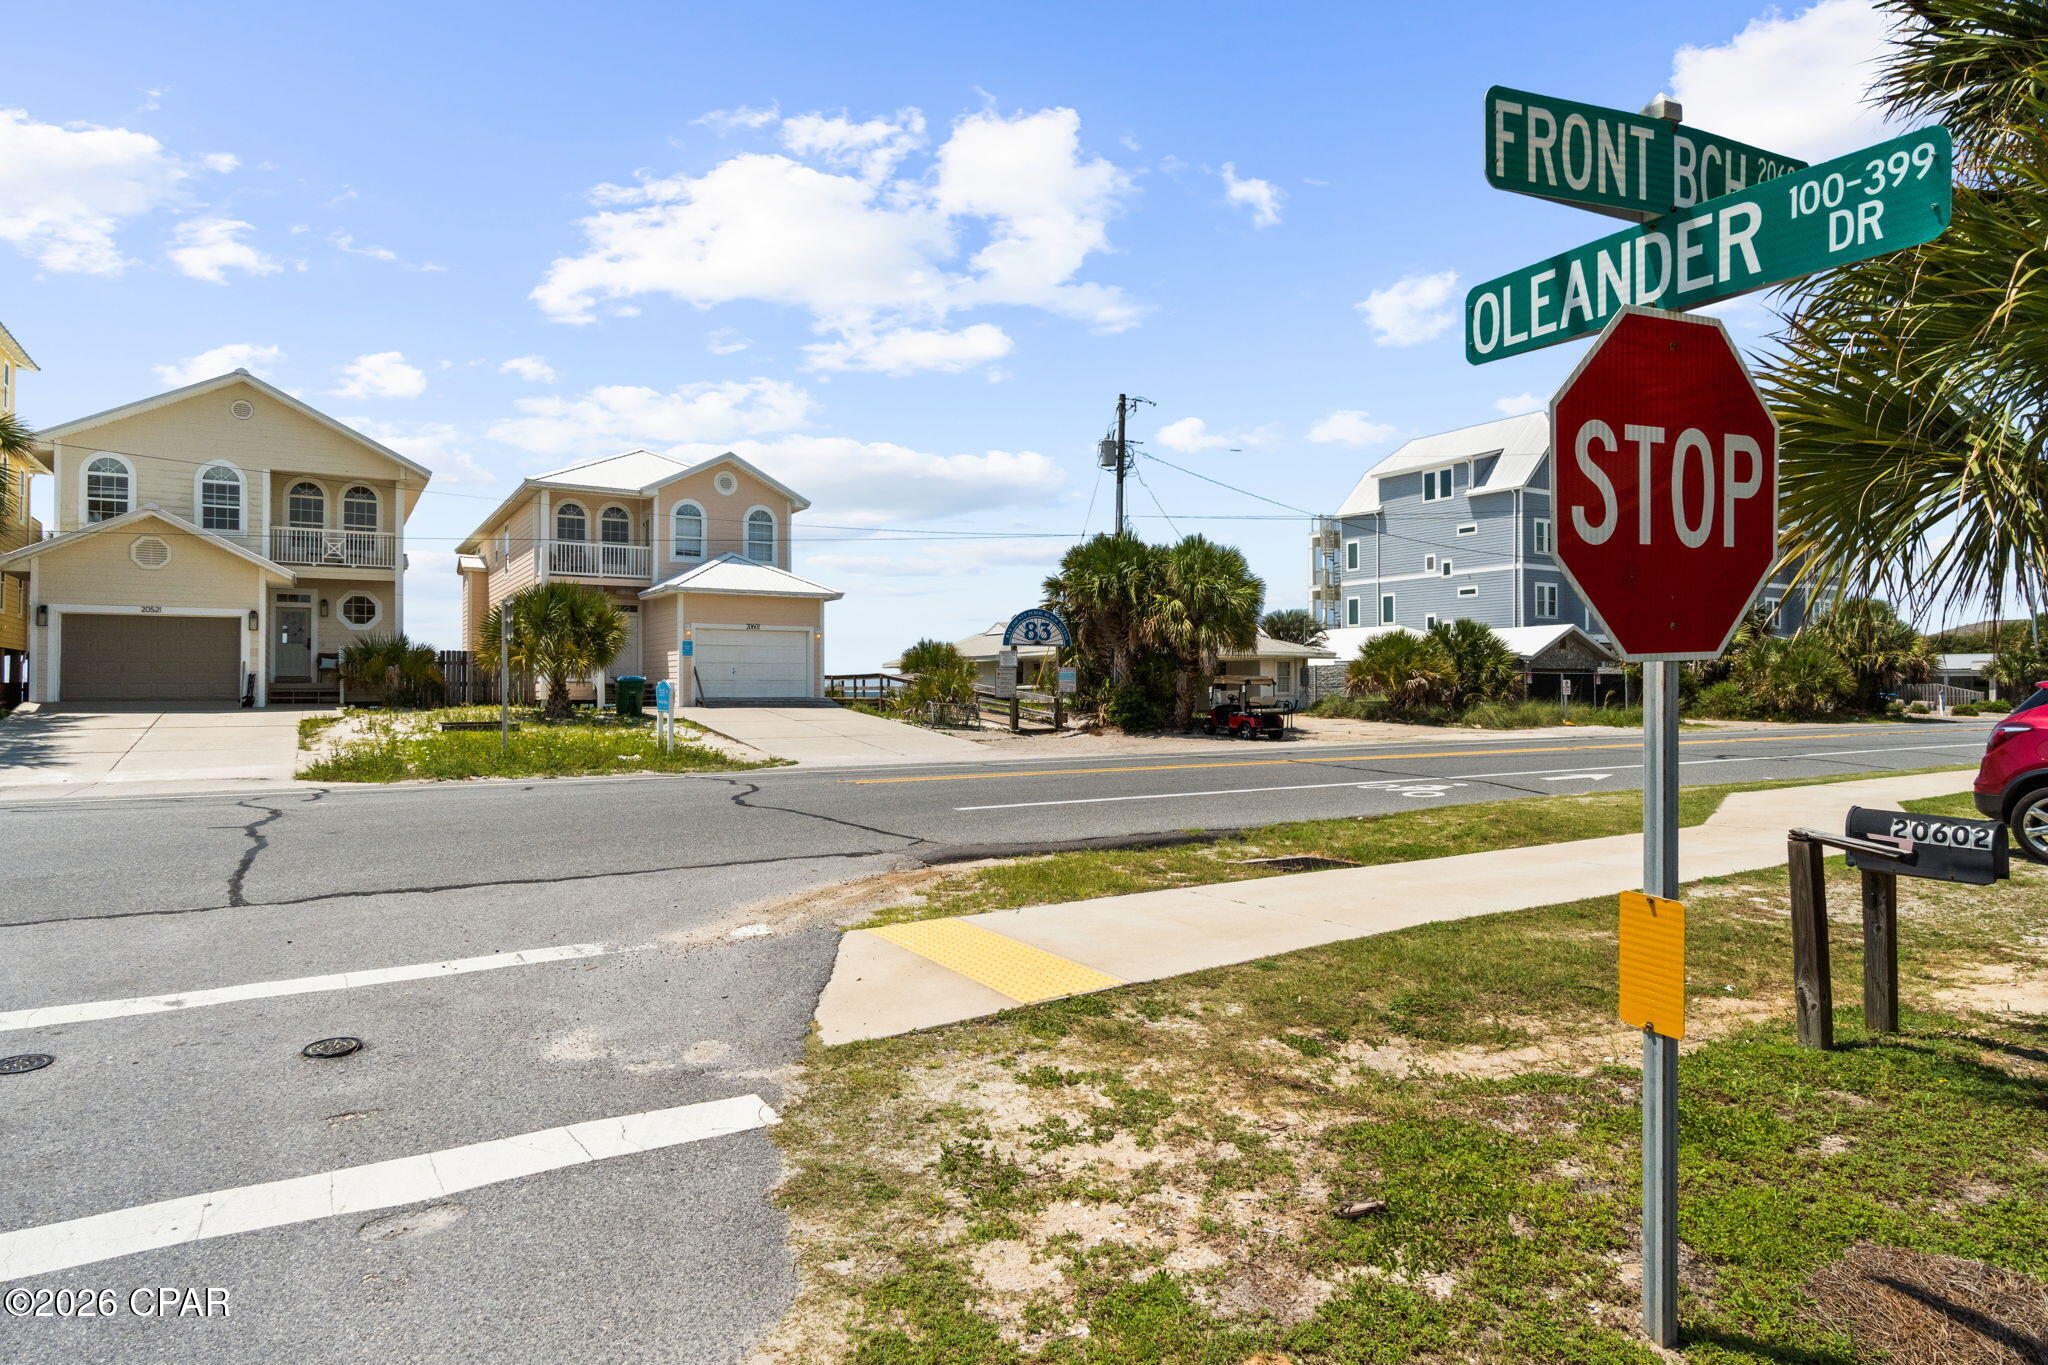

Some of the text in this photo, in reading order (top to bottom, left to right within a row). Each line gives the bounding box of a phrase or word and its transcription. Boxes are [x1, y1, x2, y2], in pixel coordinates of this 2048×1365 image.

[1495, 99, 1747, 209] FRONT BCH
[1757, 157, 1796, 184] 20
[1789, 142, 1935, 220] 100-399
[1828, 200, 1884, 253] DR
[1472, 201, 1762, 354] OLEANDER
[1571, 419, 1763, 549] STOP
[1024, 622, 1051, 641] 83
[1893, 819, 1989, 849] 20602
